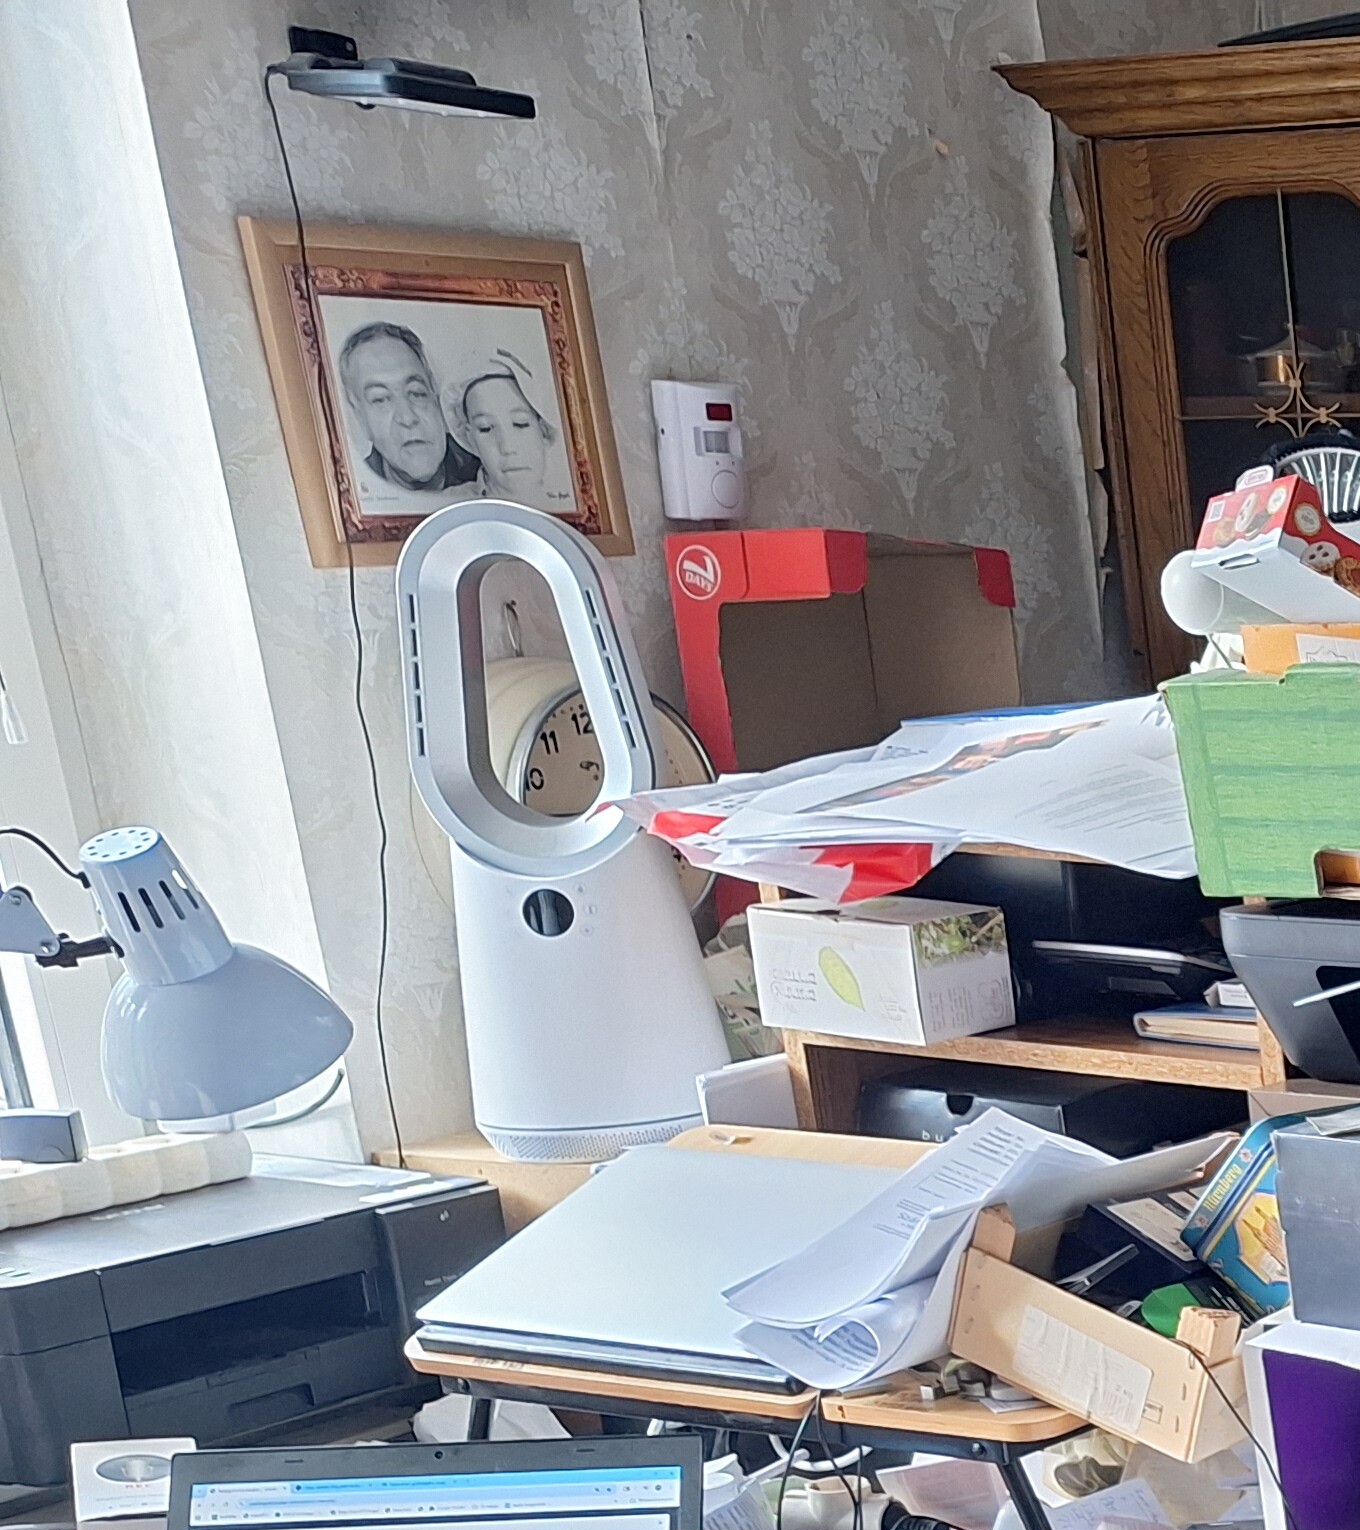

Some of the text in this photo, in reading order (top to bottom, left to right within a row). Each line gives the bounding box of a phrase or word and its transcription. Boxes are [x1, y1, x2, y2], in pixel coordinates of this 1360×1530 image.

[685, 571, 712, 593] DAYS
[571, 711, 594, 735] 12
[540, 730, 559, 755] 11
